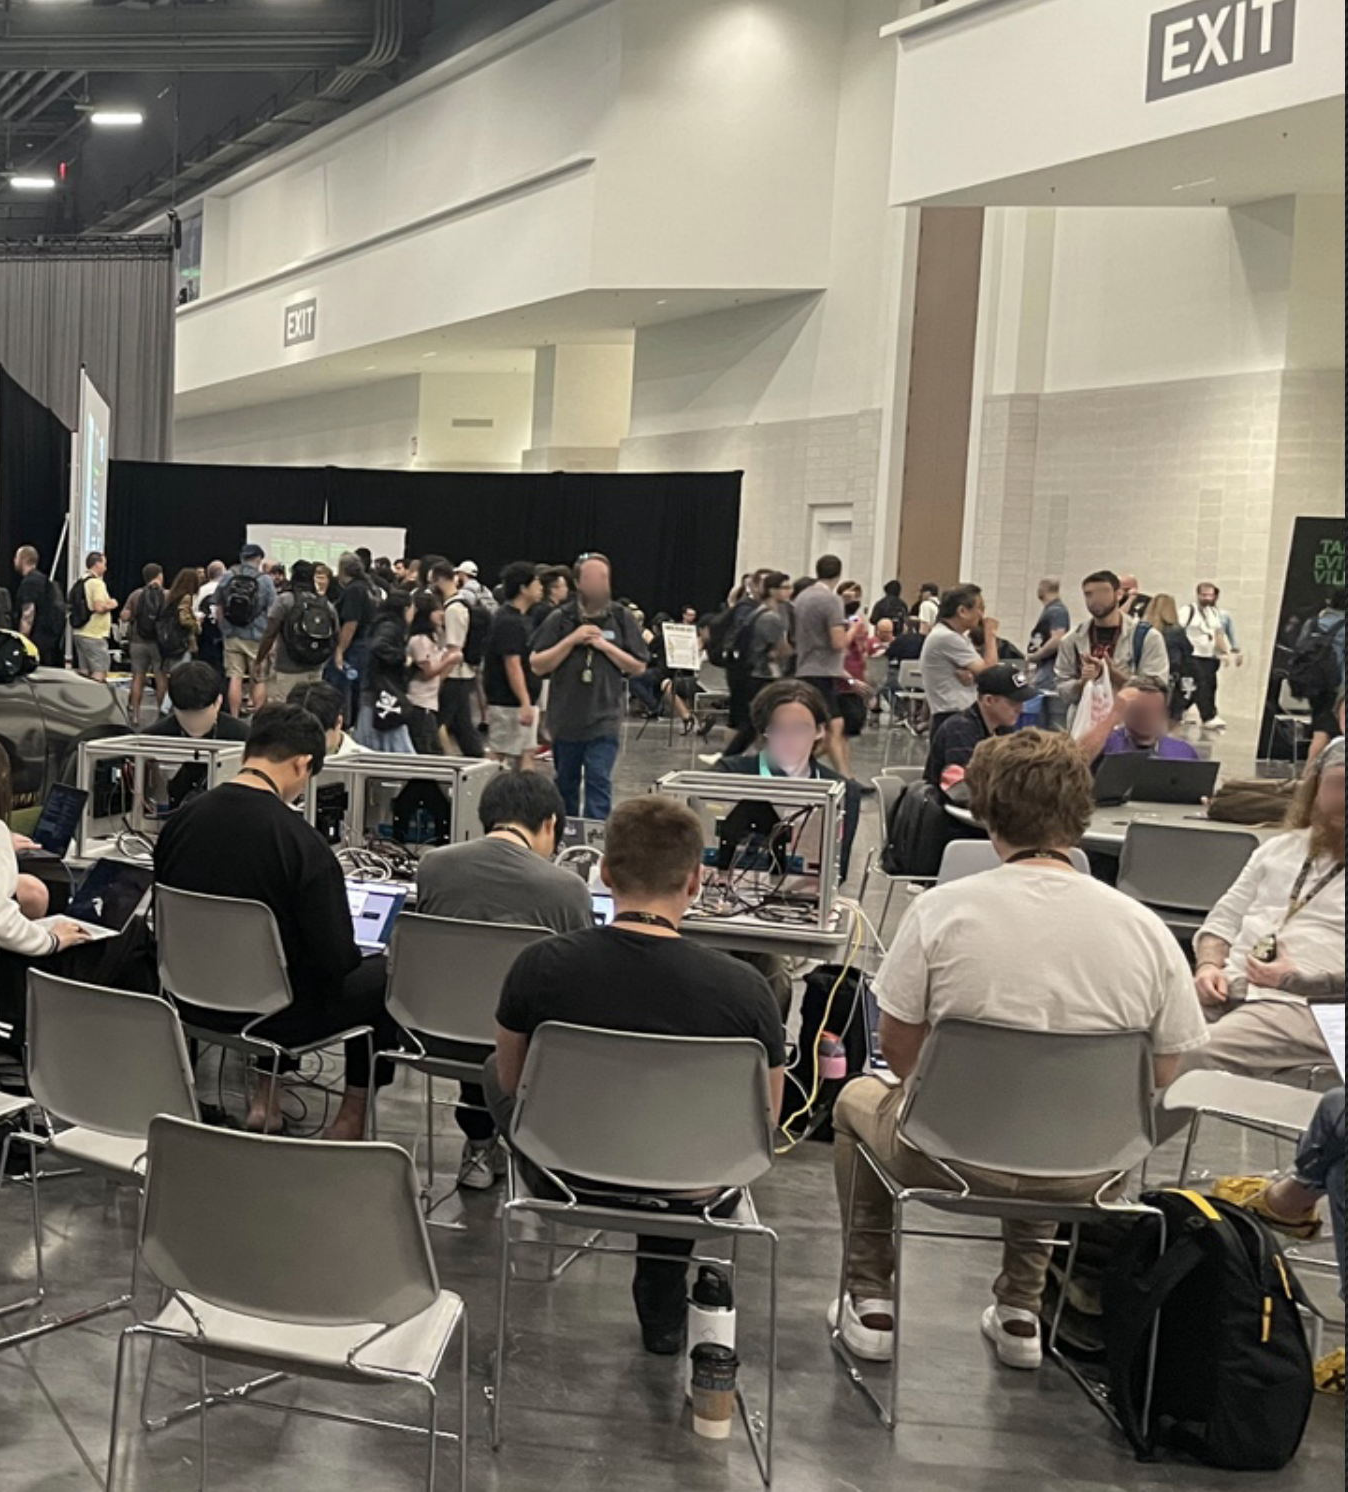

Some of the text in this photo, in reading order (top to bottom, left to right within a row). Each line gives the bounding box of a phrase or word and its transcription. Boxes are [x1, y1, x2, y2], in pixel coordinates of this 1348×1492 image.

[1162, 0, 1282, 82] EXIT
[287, 306, 313, 339] EXIT
[1320, 540, 1345, 555] TA
[1315, 555, 1345, 570] EVI
[1314, 570, 1345, 585] VIL
